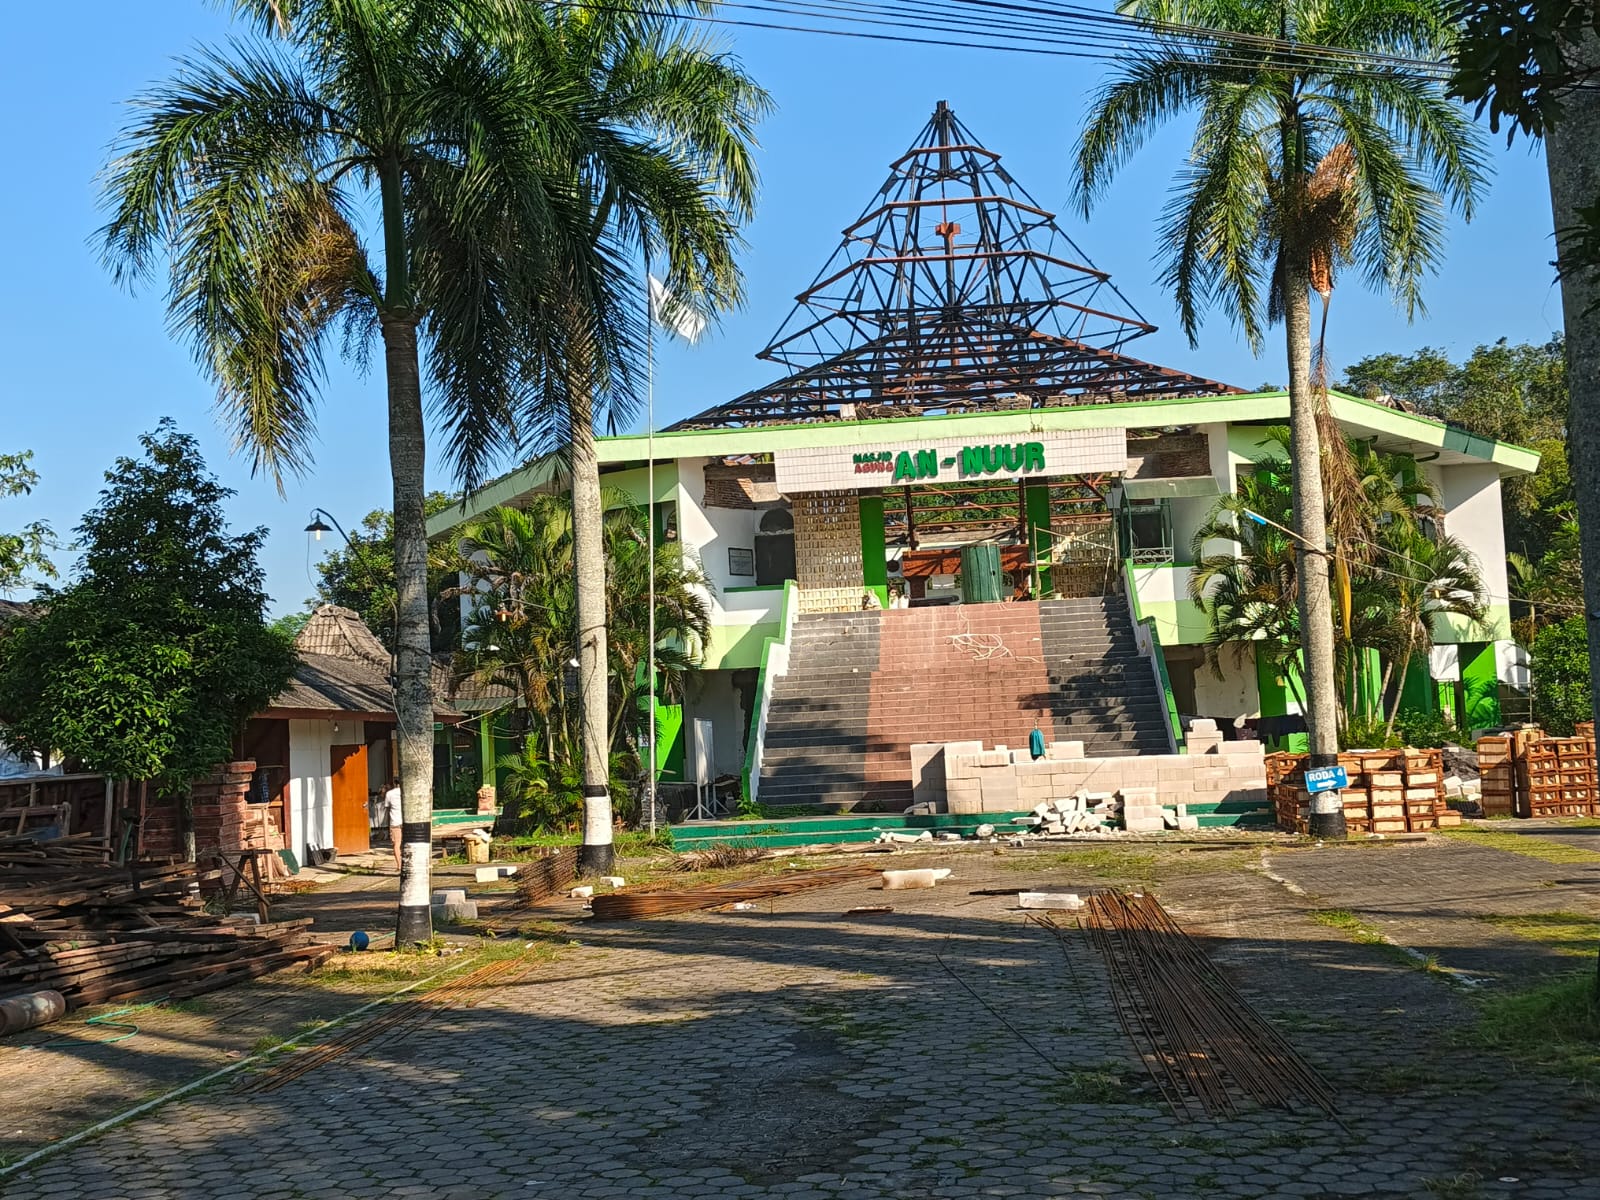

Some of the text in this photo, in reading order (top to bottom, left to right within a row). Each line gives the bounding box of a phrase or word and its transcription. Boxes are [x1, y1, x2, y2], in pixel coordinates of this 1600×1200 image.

[853, 451, 892, 464] MASJID
[854, 461, 894, 474] AGUNG
[1308, 768, 1344, 782] RODA 4
